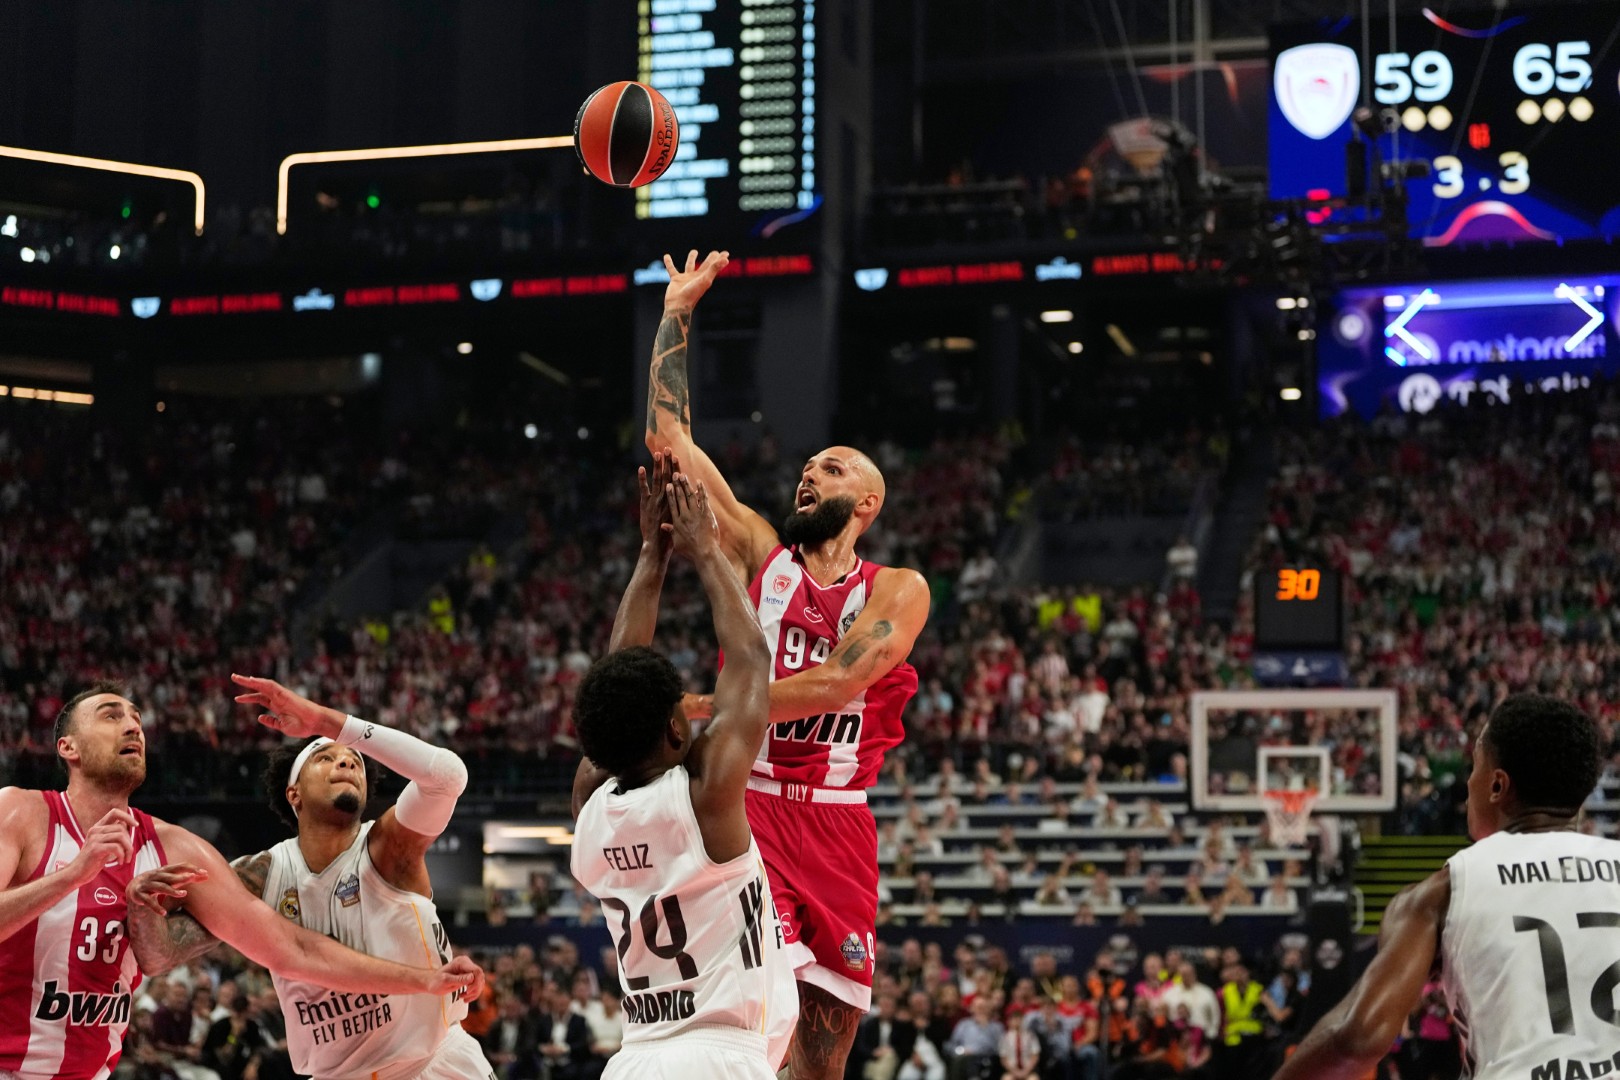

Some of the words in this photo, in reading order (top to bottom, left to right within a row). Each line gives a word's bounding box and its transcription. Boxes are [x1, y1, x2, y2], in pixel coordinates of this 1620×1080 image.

[1374, 49, 1454, 105] 59
[1512, 40, 1592, 95] 65
[1275, 568, 1321, 601] 30
[783, 626, 830, 670] 94
[767, 711, 862, 746] win
[786, 783, 809, 803] OLY
[603, 843, 653, 871] FELIZ
[77, 916, 125, 964] 33
[600, 893, 699, 991] 24
[35, 980, 132, 1026] bwin
[294, 991, 390, 1026] Emira
[313, 1022, 336, 1046] FLY
[341, 1002, 392, 1038] BETTER
[622, 990, 696, 1024] MADRID
